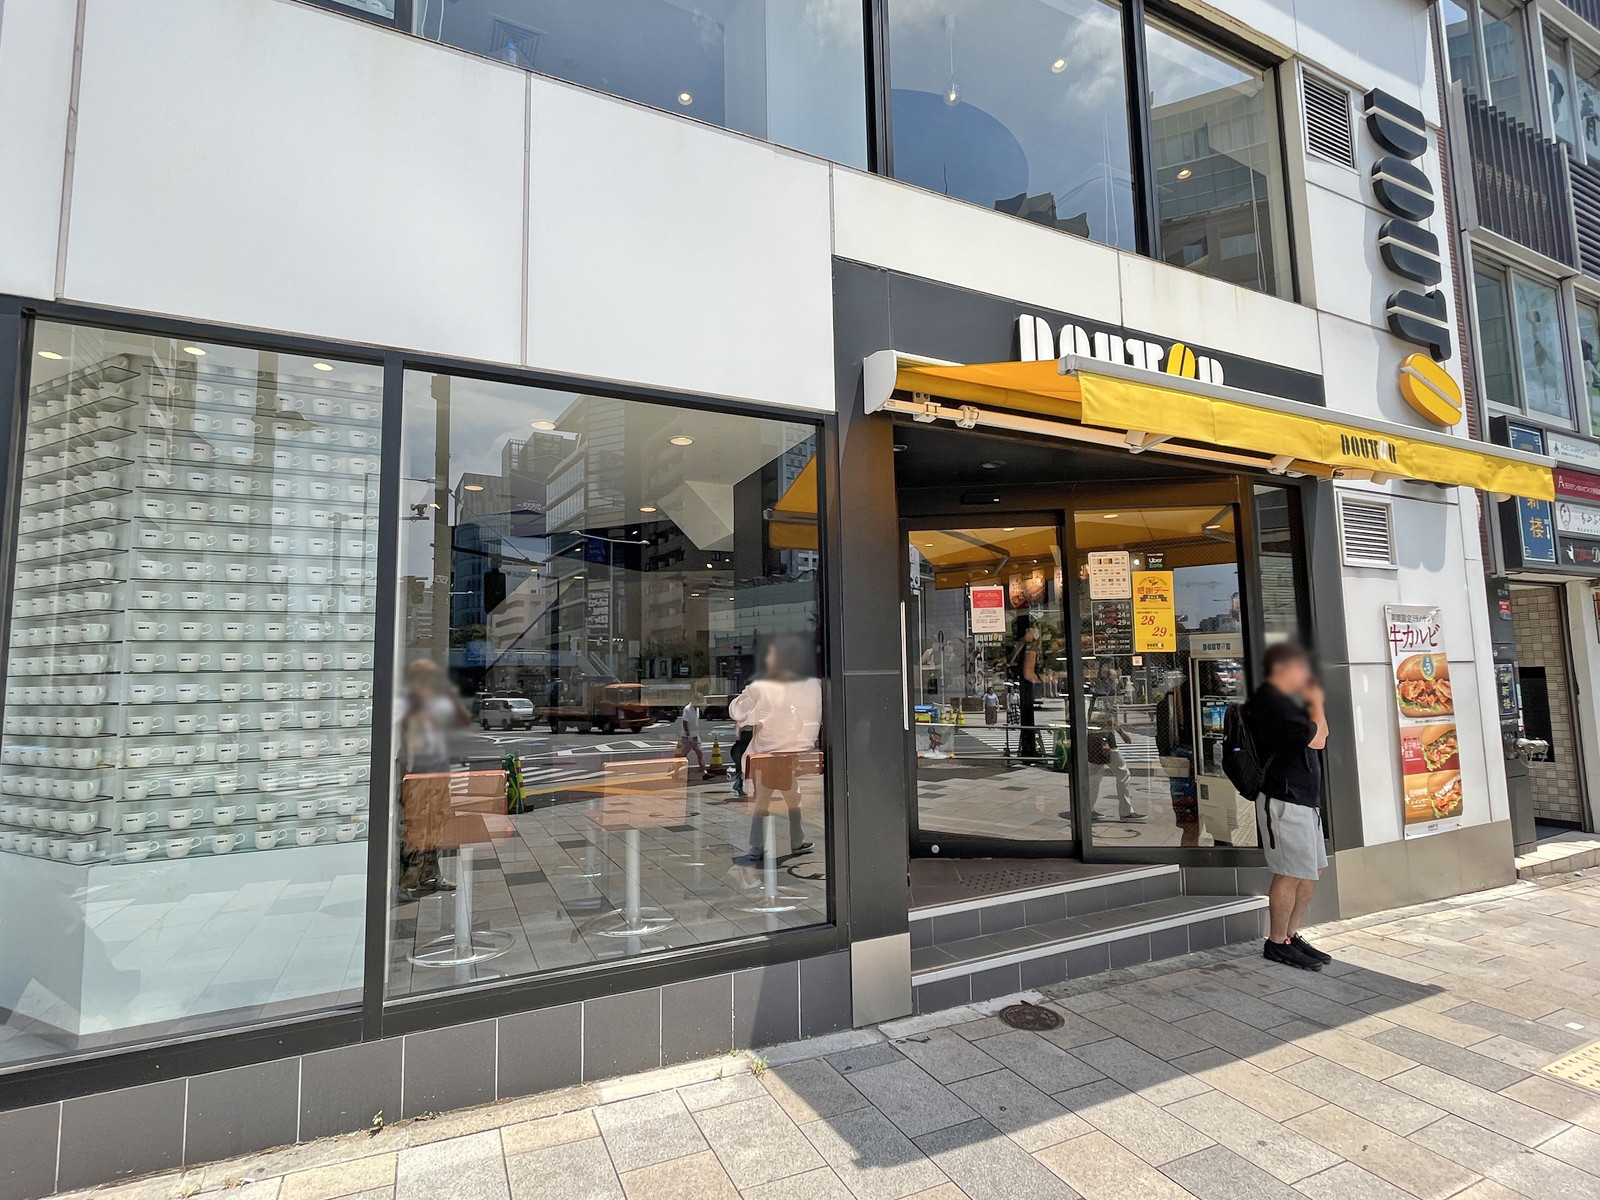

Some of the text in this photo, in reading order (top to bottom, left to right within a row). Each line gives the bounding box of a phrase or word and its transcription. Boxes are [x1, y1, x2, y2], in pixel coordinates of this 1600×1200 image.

[1364, 88, 1462, 428] DOUTO
[1340, 434, 1397, 464] DOUTOR
[1141, 615, 1155, 626] 28
[1152, 627, 1167, 637] 29
[1389, 624, 1440, 656] 牛カルビ
